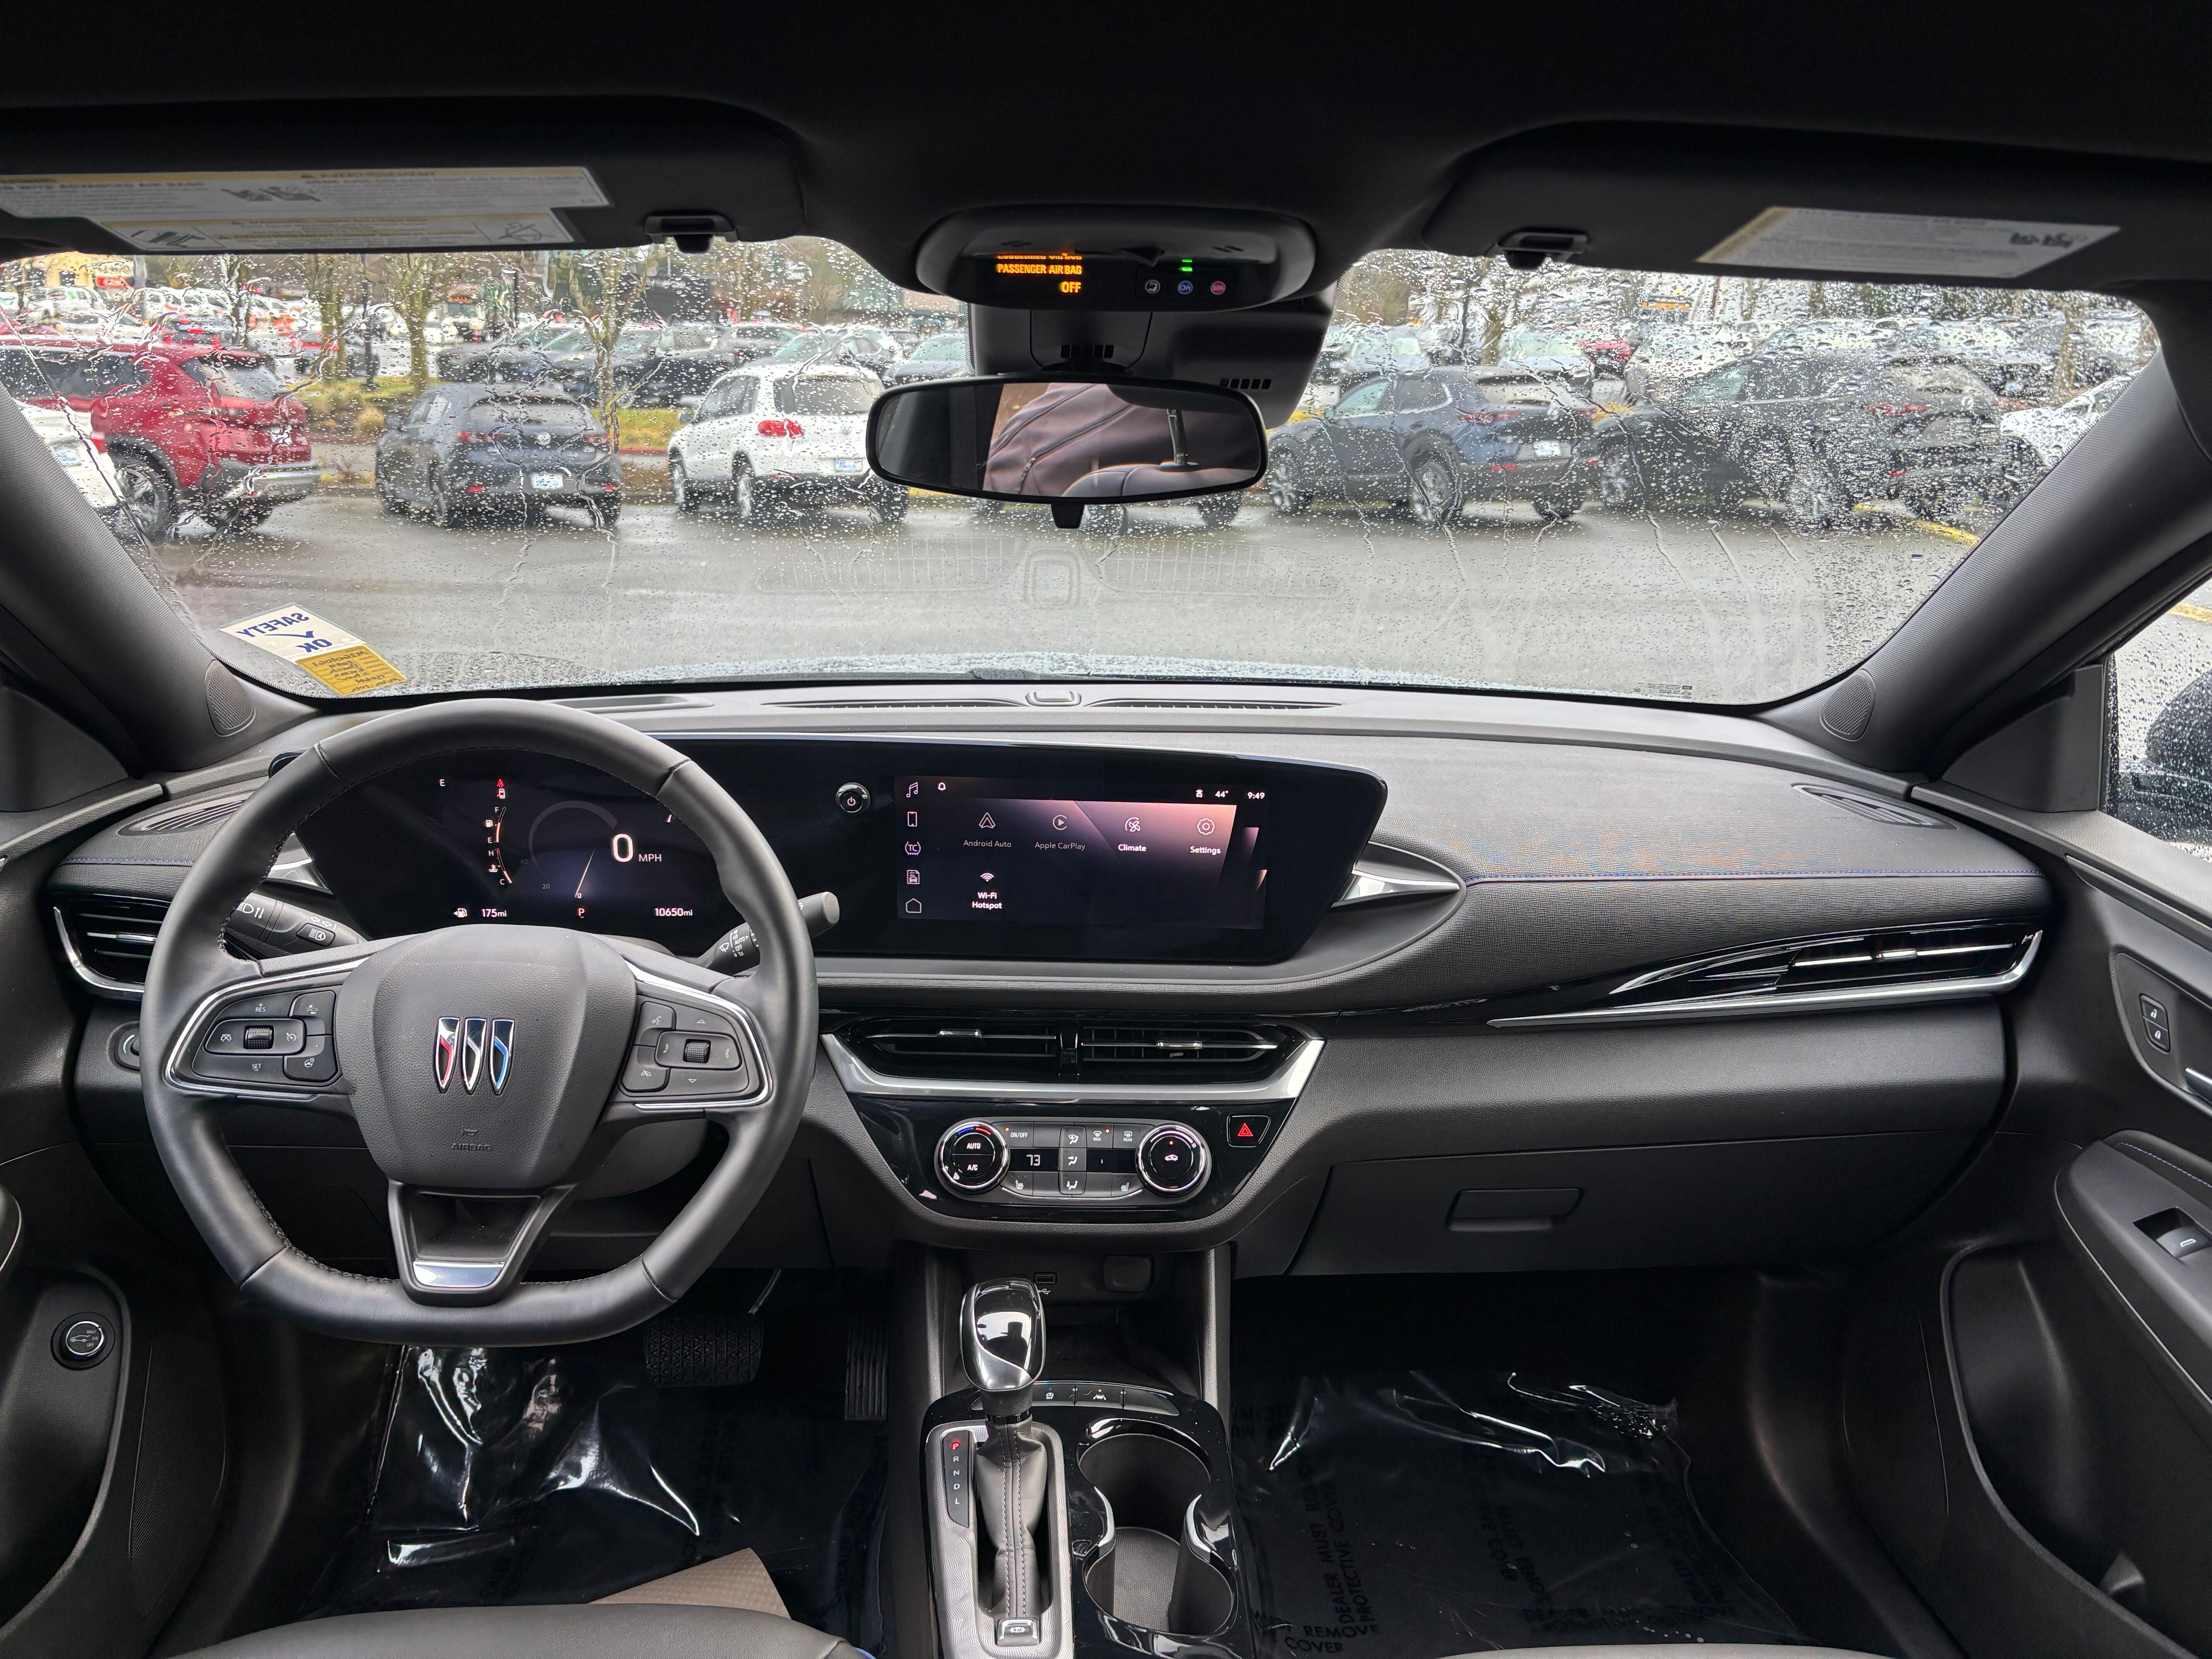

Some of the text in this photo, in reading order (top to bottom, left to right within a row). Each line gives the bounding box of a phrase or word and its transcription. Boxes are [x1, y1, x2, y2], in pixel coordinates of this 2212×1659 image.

[996, 264, 1082, 275] PASSENGER AIR BAG
[1061, 281, 1081, 293] OFF
[1247, 792, 1265, 800] 9:49
[612, 833, 662, 862] 0 MPH
[963, 839, 993, 848] Android
[1034, 842, 1086, 851] Apple CarPlay
[1118, 843, 1147, 852] Climate
[1189, 846, 1221, 855] Settings
[972, 901, 1003, 910] Hotspot
[578, 908, 585, 916] P
[735, 936, 745, 945] AUTO
[452, 1143, 492, 1152] AIRBAG
[1026, 1154, 1041, 1166] 73
[1303, 1623, 1380, 1638] REMOVE
[1284, 1636, 1344, 1654] COVER
